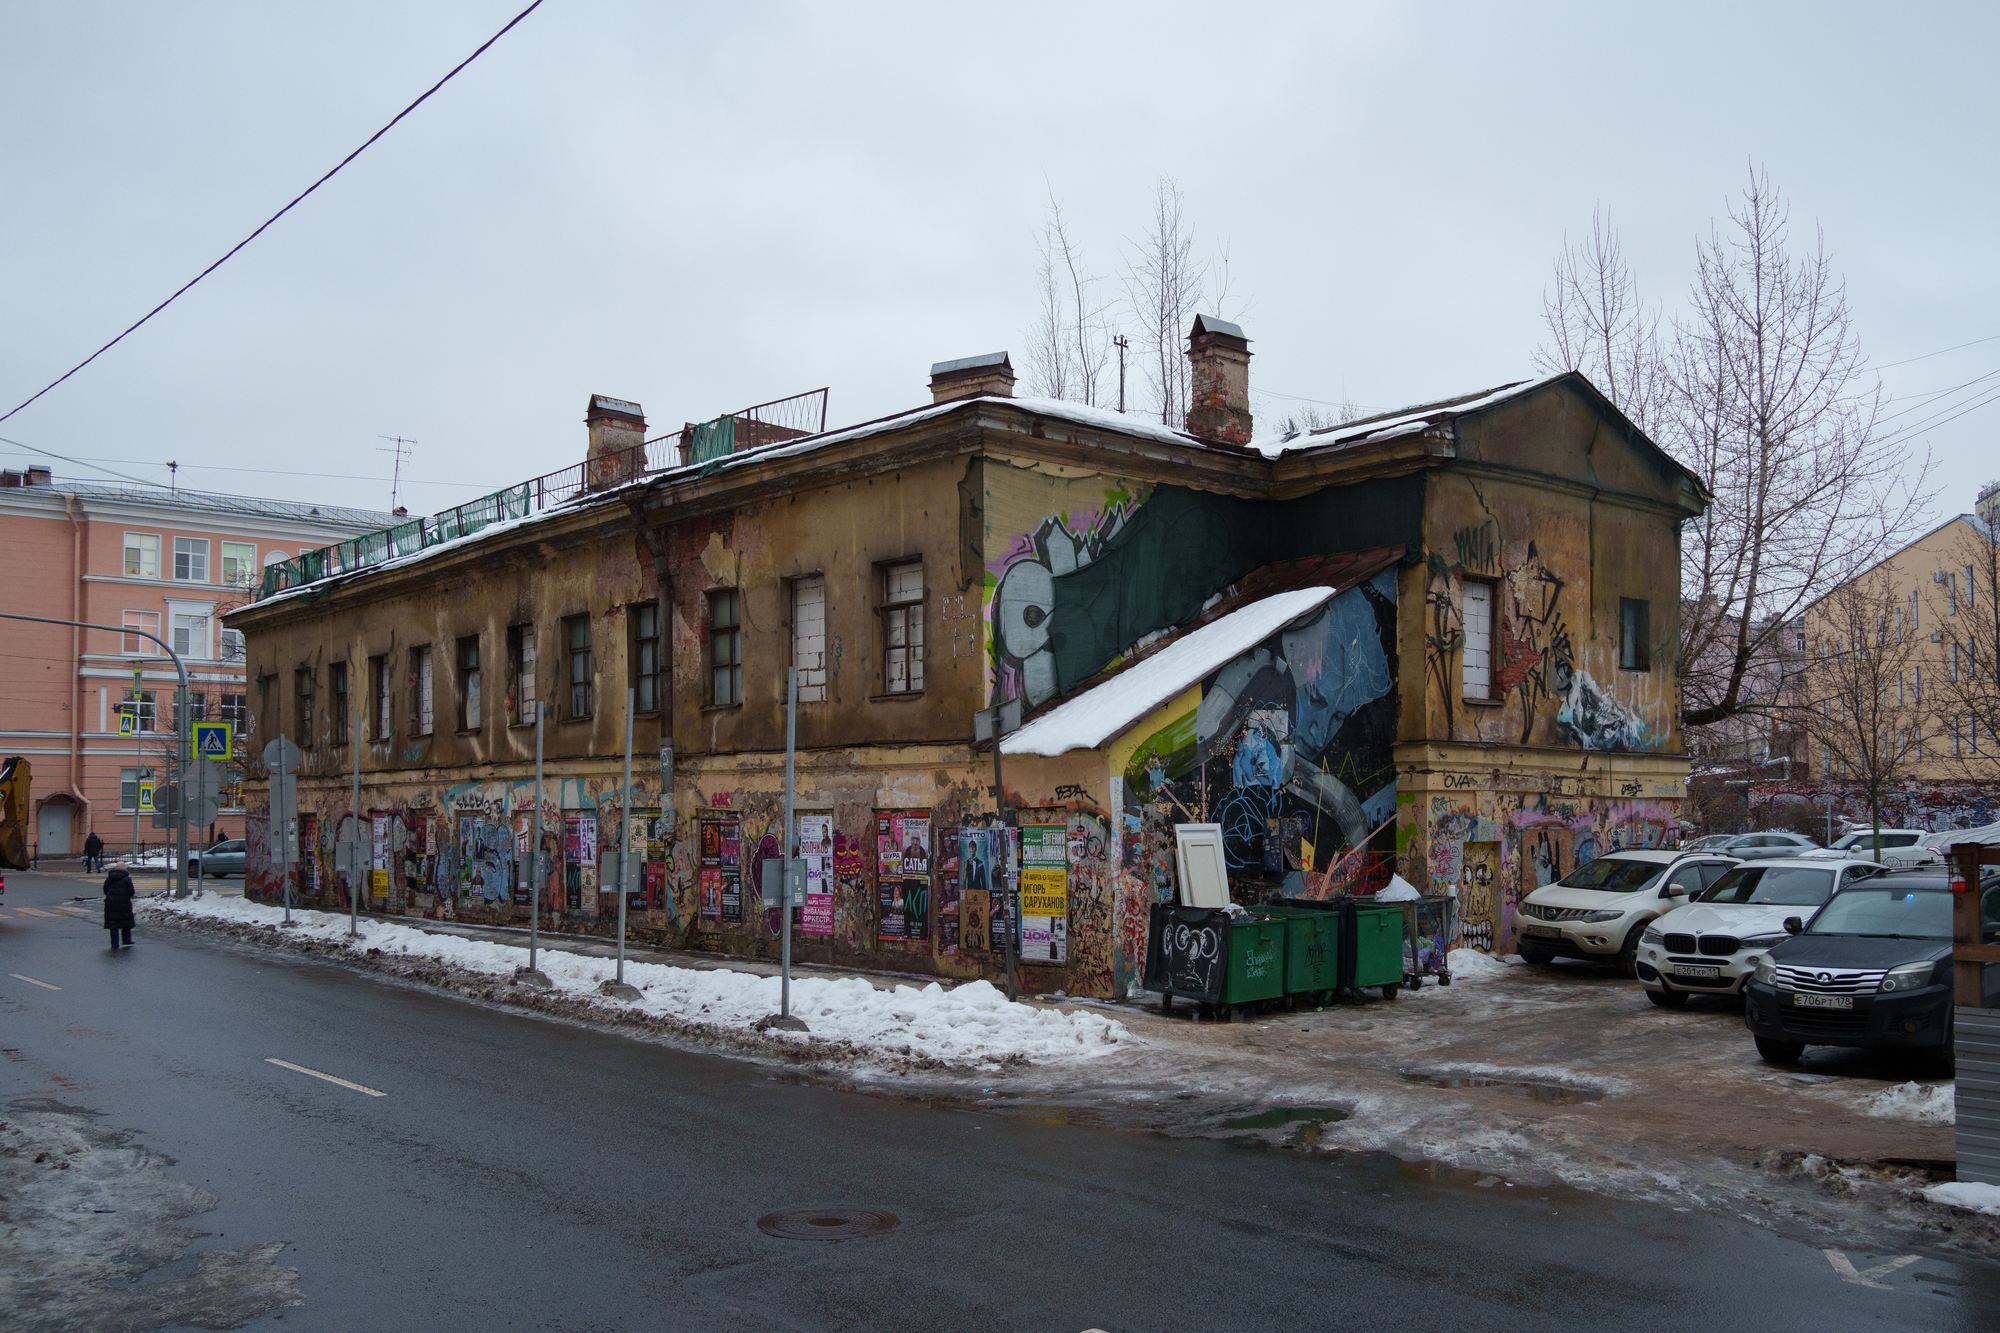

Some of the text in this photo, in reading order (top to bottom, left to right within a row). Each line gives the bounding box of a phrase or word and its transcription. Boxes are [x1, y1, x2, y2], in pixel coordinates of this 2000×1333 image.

[1444, 775, 1471, 789] OVA
[903, 857, 928, 871] САТЬЯ
[1023, 883, 1046, 894] ИГОРЬ
[1023, 895, 1065, 909] САРУХАНОВ
[1022, 930, 1050, 941] ЦОЙ
